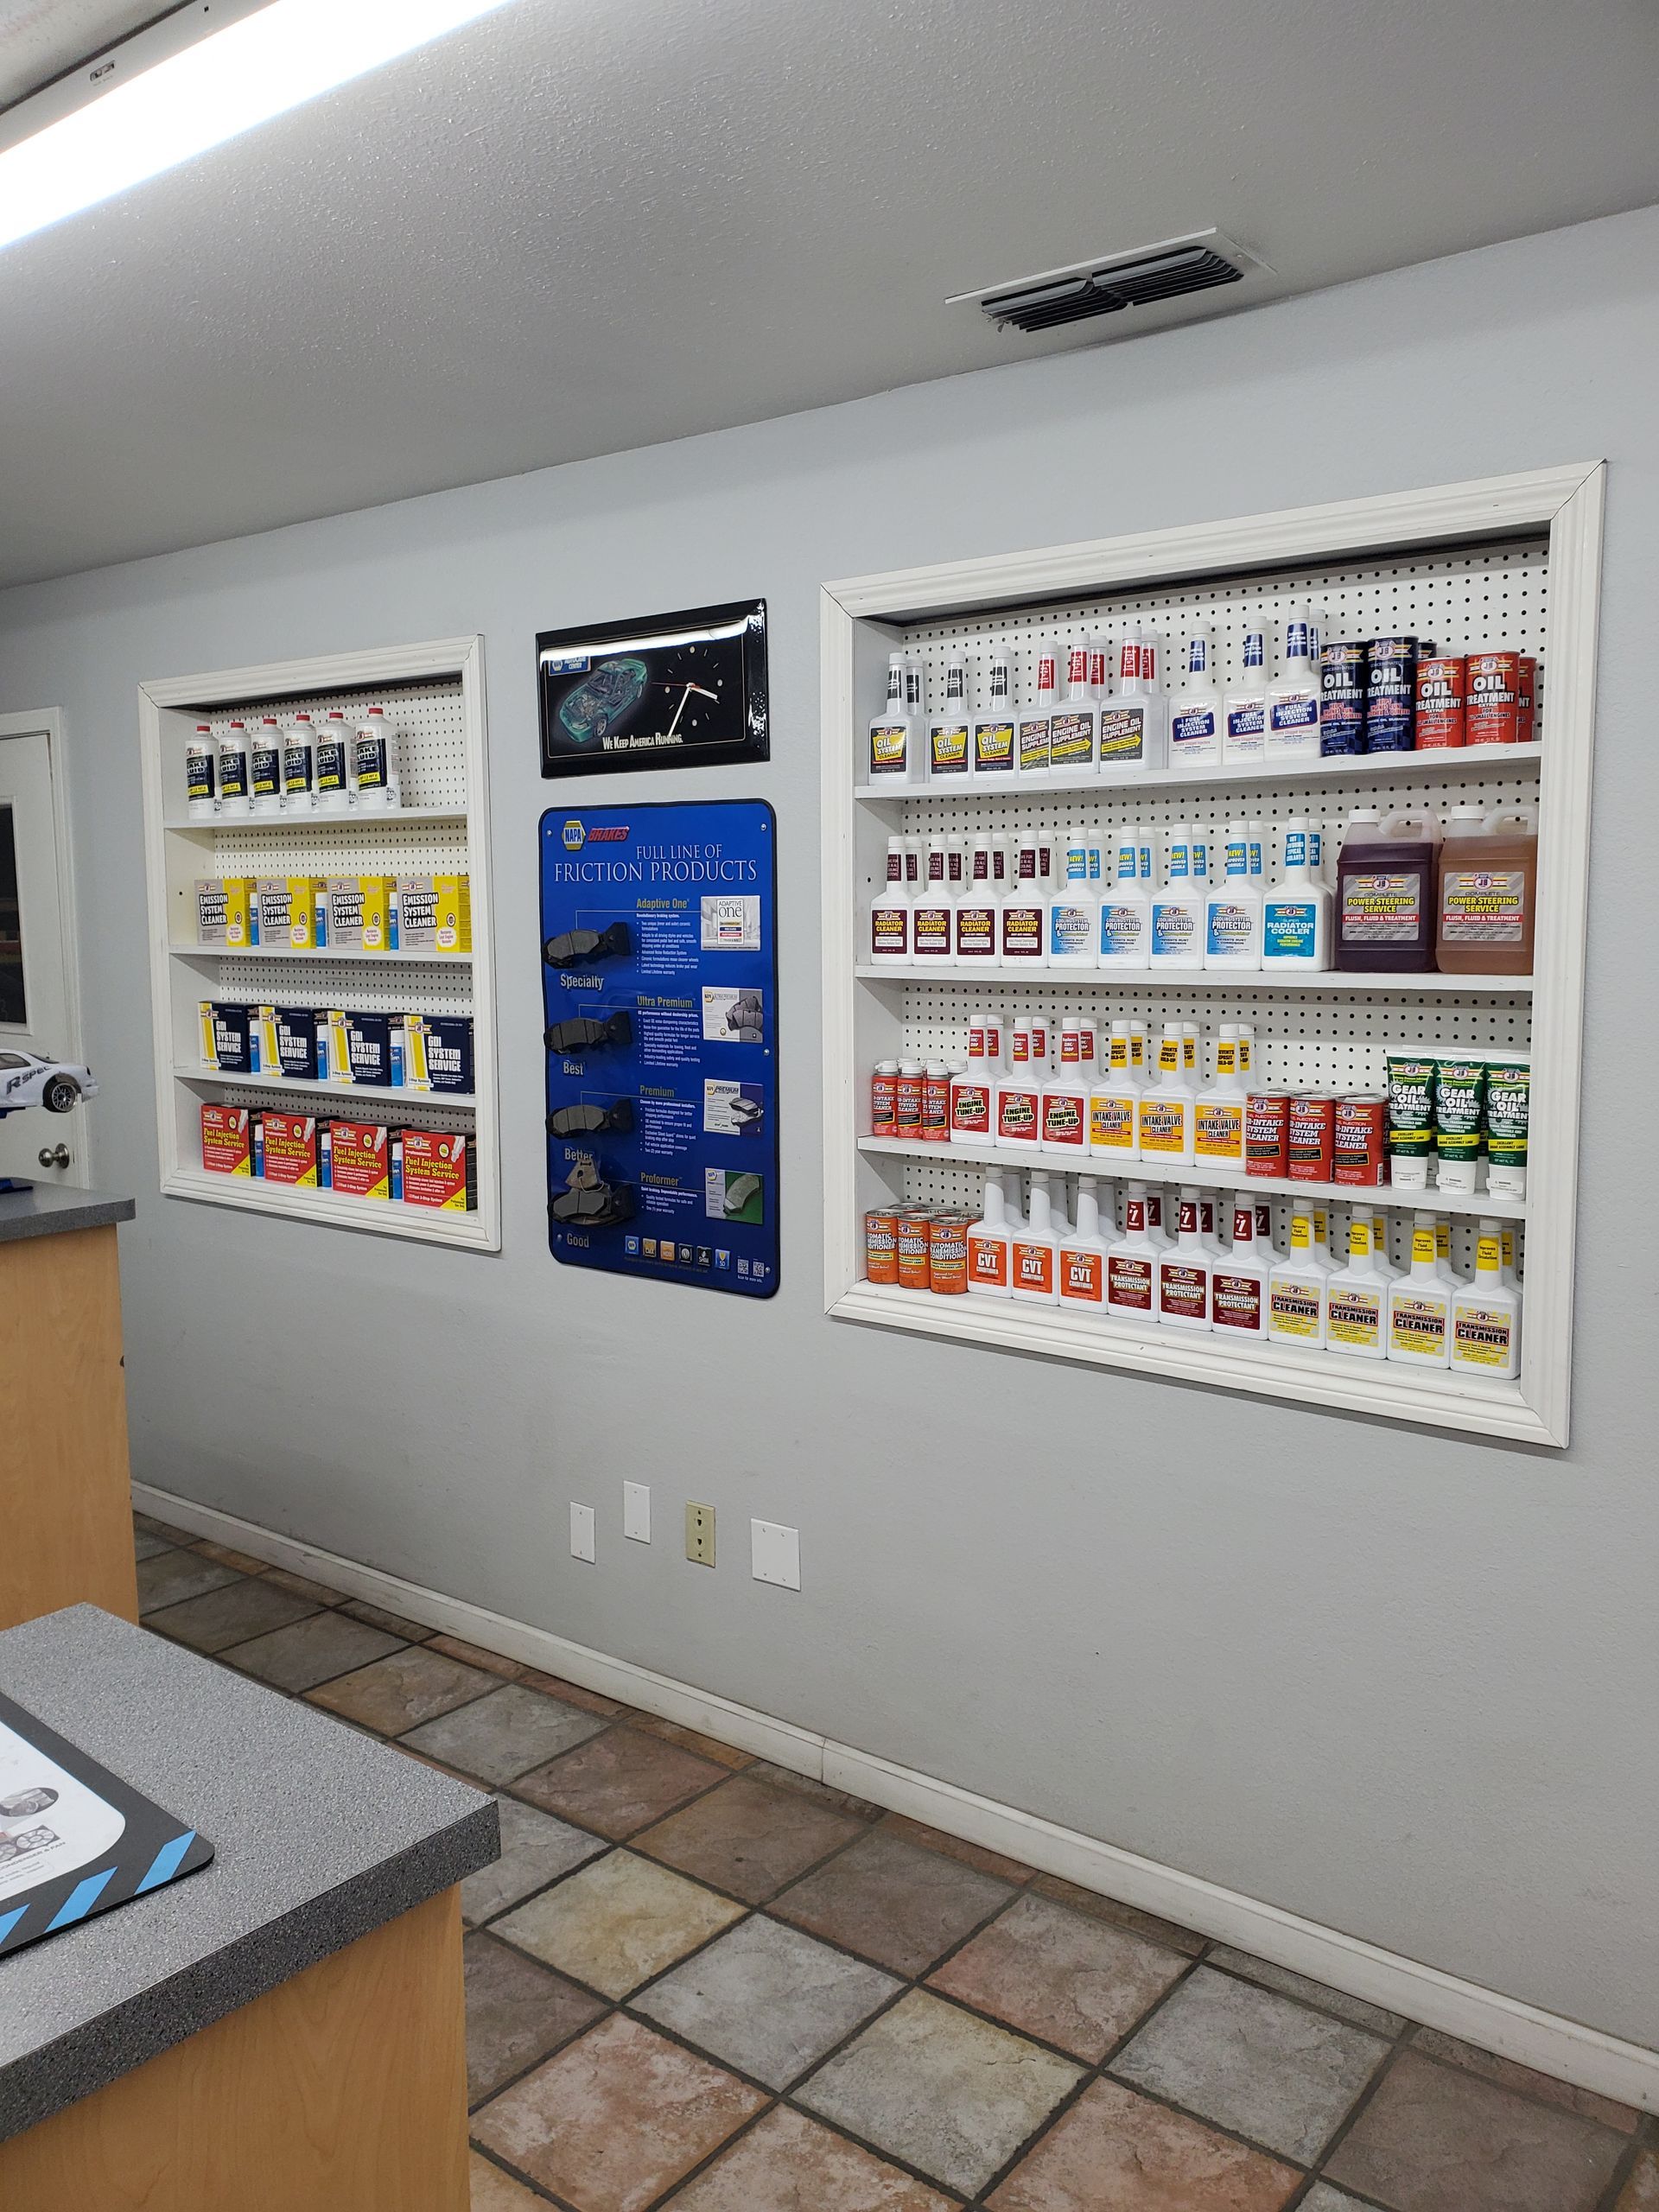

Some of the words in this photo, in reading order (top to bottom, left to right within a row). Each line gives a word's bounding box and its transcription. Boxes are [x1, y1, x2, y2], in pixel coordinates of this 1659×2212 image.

[1324, 673, 1352, 688] OIL
[1371, 668, 1401, 683] OIL
[1473, 676, 1505, 691] OIL
[1421, 682, 1452, 697] OIL
[1276, 707, 1312, 717] INJECTION
[1103, 721, 1128, 733] ENGINE
[1178, 720, 1210, 728] INJECTION
[1279, 717, 1309, 726] CLEANER
[1052, 726, 1077, 737] ENGINE
[1052, 729, 1091, 744] SUPPLEMENT
[1103, 725, 1141, 740] SUPPLEMENT
[1180, 728, 1207, 737] CLEANER
[877, 738, 891, 748] OIL
[937, 738, 951, 748] OIL
[982, 734, 996, 745] OIL
[877, 743, 903, 755] SYSTEM
[938, 745, 962, 755] SYSTEM
[982, 741, 1007, 752] SYSTEM
[565, 829, 581, 842] NAPA
[588, 826, 629, 842] BRAKES
[637, 846, 666, 860] FULL
[671, 845, 702, 859] LINE
[705, 844, 722, 858] OF
[555, 861, 642, 882] FRICTION
[652, 861, 757, 880] PRODUCTS
[200, 894, 227, 906] EMISSION
[262, 894, 292, 906] EMISSION
[332, 894, 365, 906] EMISSION
[403, 894, 438, 906] EMISSION
[637, 899, 671, 909] Adaptive
[672, 899, 687, 908] One
[200, 906, 226, 915] SYSTEM
[264, 906, 287, 916] SYSTEM
[334, 906, 358, 916] SYSTEM
[404, 906, 431, 917] SYSTEM
[719, 906, 741, 918] one
[201, 914, 226, 925] CLEANER
[264, 915, 290, 926] CLEANER
[334, 916, 363, 926] CLEANER
[404, 917, 436, 927] CLEANER
[1156, 923, 1193, 931] PROTECTOR
[1212, 922, 1251, 931] PROTECTOR
[561, 974, 604, 990] Specialty
[637, 996, 656, 1006] Ultra
[658, 997, 693, 1007] Premium
[279, 1026, 290, 1036] GDI
[351, 1031, 362, 1042] GDI
[280, 1037, 307, 1048] SYSTEM
[351, 1042, 380, 1052] SYSTEM
[428, 1036, 442, 1047] GDI
[280, 1047, 307, 1058] SERVICE
[429, 1048, 461, 1058] SYSTEM
[352, 1052, 380, 1065] SERVICE
[429, 1058, 461, 1071] SERVICE
[563, 1062, 583, 1075] Best
[22, 1066, 51, 1084] SPEC
[640, 1085, 674, 1096] Premium
[1392, 1084, 1426, 1095] GEAR
[1440, 1087, 1474, 1098] GEAR
[1397, 1094, 1419, 1103] OIL
[1491, 1090, 1526, 1103] GEAR
[1446, 1097, 1467, 1108] OIL
[1497, 1102, 1519, 1111] OIL
[956, 1107, 985, 1116] TUNE-UP
[1005, 1107, 1030, 1116] ENGINE
[1050, 1110, 1075, 1119] ENGINE
[1093, 1111, 1111, 1122] INTAKE
[1113, 1111, 1130, 1121] VALVE
[1003, 1114, 1033, 1122] TUNE-UP
[1047, 1118, 1078, 1127] TUNE-UP
[1141, 1116, 1162, 1126] INTAKE
[1163, 1116, 1181, 1126] VALVE
[1198, 1120, 1219, 1130] INTAKE
[1220, 1120, 1240, 1129] VALVE
[265, 1136, 278, 1146] Fuel
[280, 1138, 305, 1149] Injection
[265, 1145, 284, 1156] System
[286, 1147, 310, 1158] Service
[334, 1147, 347, 1156] Fuel
[349, 1148, 376, 1159] Injection
[565, 1148, 593, 1160] Better
[334, 1154, 354, 1166] System
[356, 1157, 382, 1168] Service
[405, 1157, 420, 1167] Fuel
[422, 1159, 452, 1171] Injection
[405, 1166, 429, 1178] System
[430, 1168, 459, 1179] Service
[640, 1173, 678, 1186] Proformer
[567, 1233, 589, 1248] Good
[978, 1253, 997, 1268] CVT
[1022, 1259, 1042, 1275] CVT
[1071, 1267, 1091, 1282] CVT
[1110, 1275, 1150, 1286] TRANSMISSION
[1113, 1281, 1147, 1291] PROTECTANT
[1162, 1282, 1205, 1294] TRANSMISSION
[1166, 1289, 1200, 1300] PROTECTANT
[1216, 1294, 1258, 1304] TRANSMISSION
[1218, 1300, 1255, 1311] PROTECTANT
[1273, 1296, 1317, 1306] TRANSMISSION
[1273, 1302, 1318, 1316] CLEANER
[1332, 1304, 1376, 1315] TRANSMISSION
[1331, 1310, 1376, 1325] CLEANER
[1395, 1312, 1442, 1324] TRANSMISSION
[1395, 1319, 1443, 1334] CLEANER
[1459, 1321, 1507, 1335] TRANSMISSION
[1458, 1328, 1507, 1344] CLEANER
